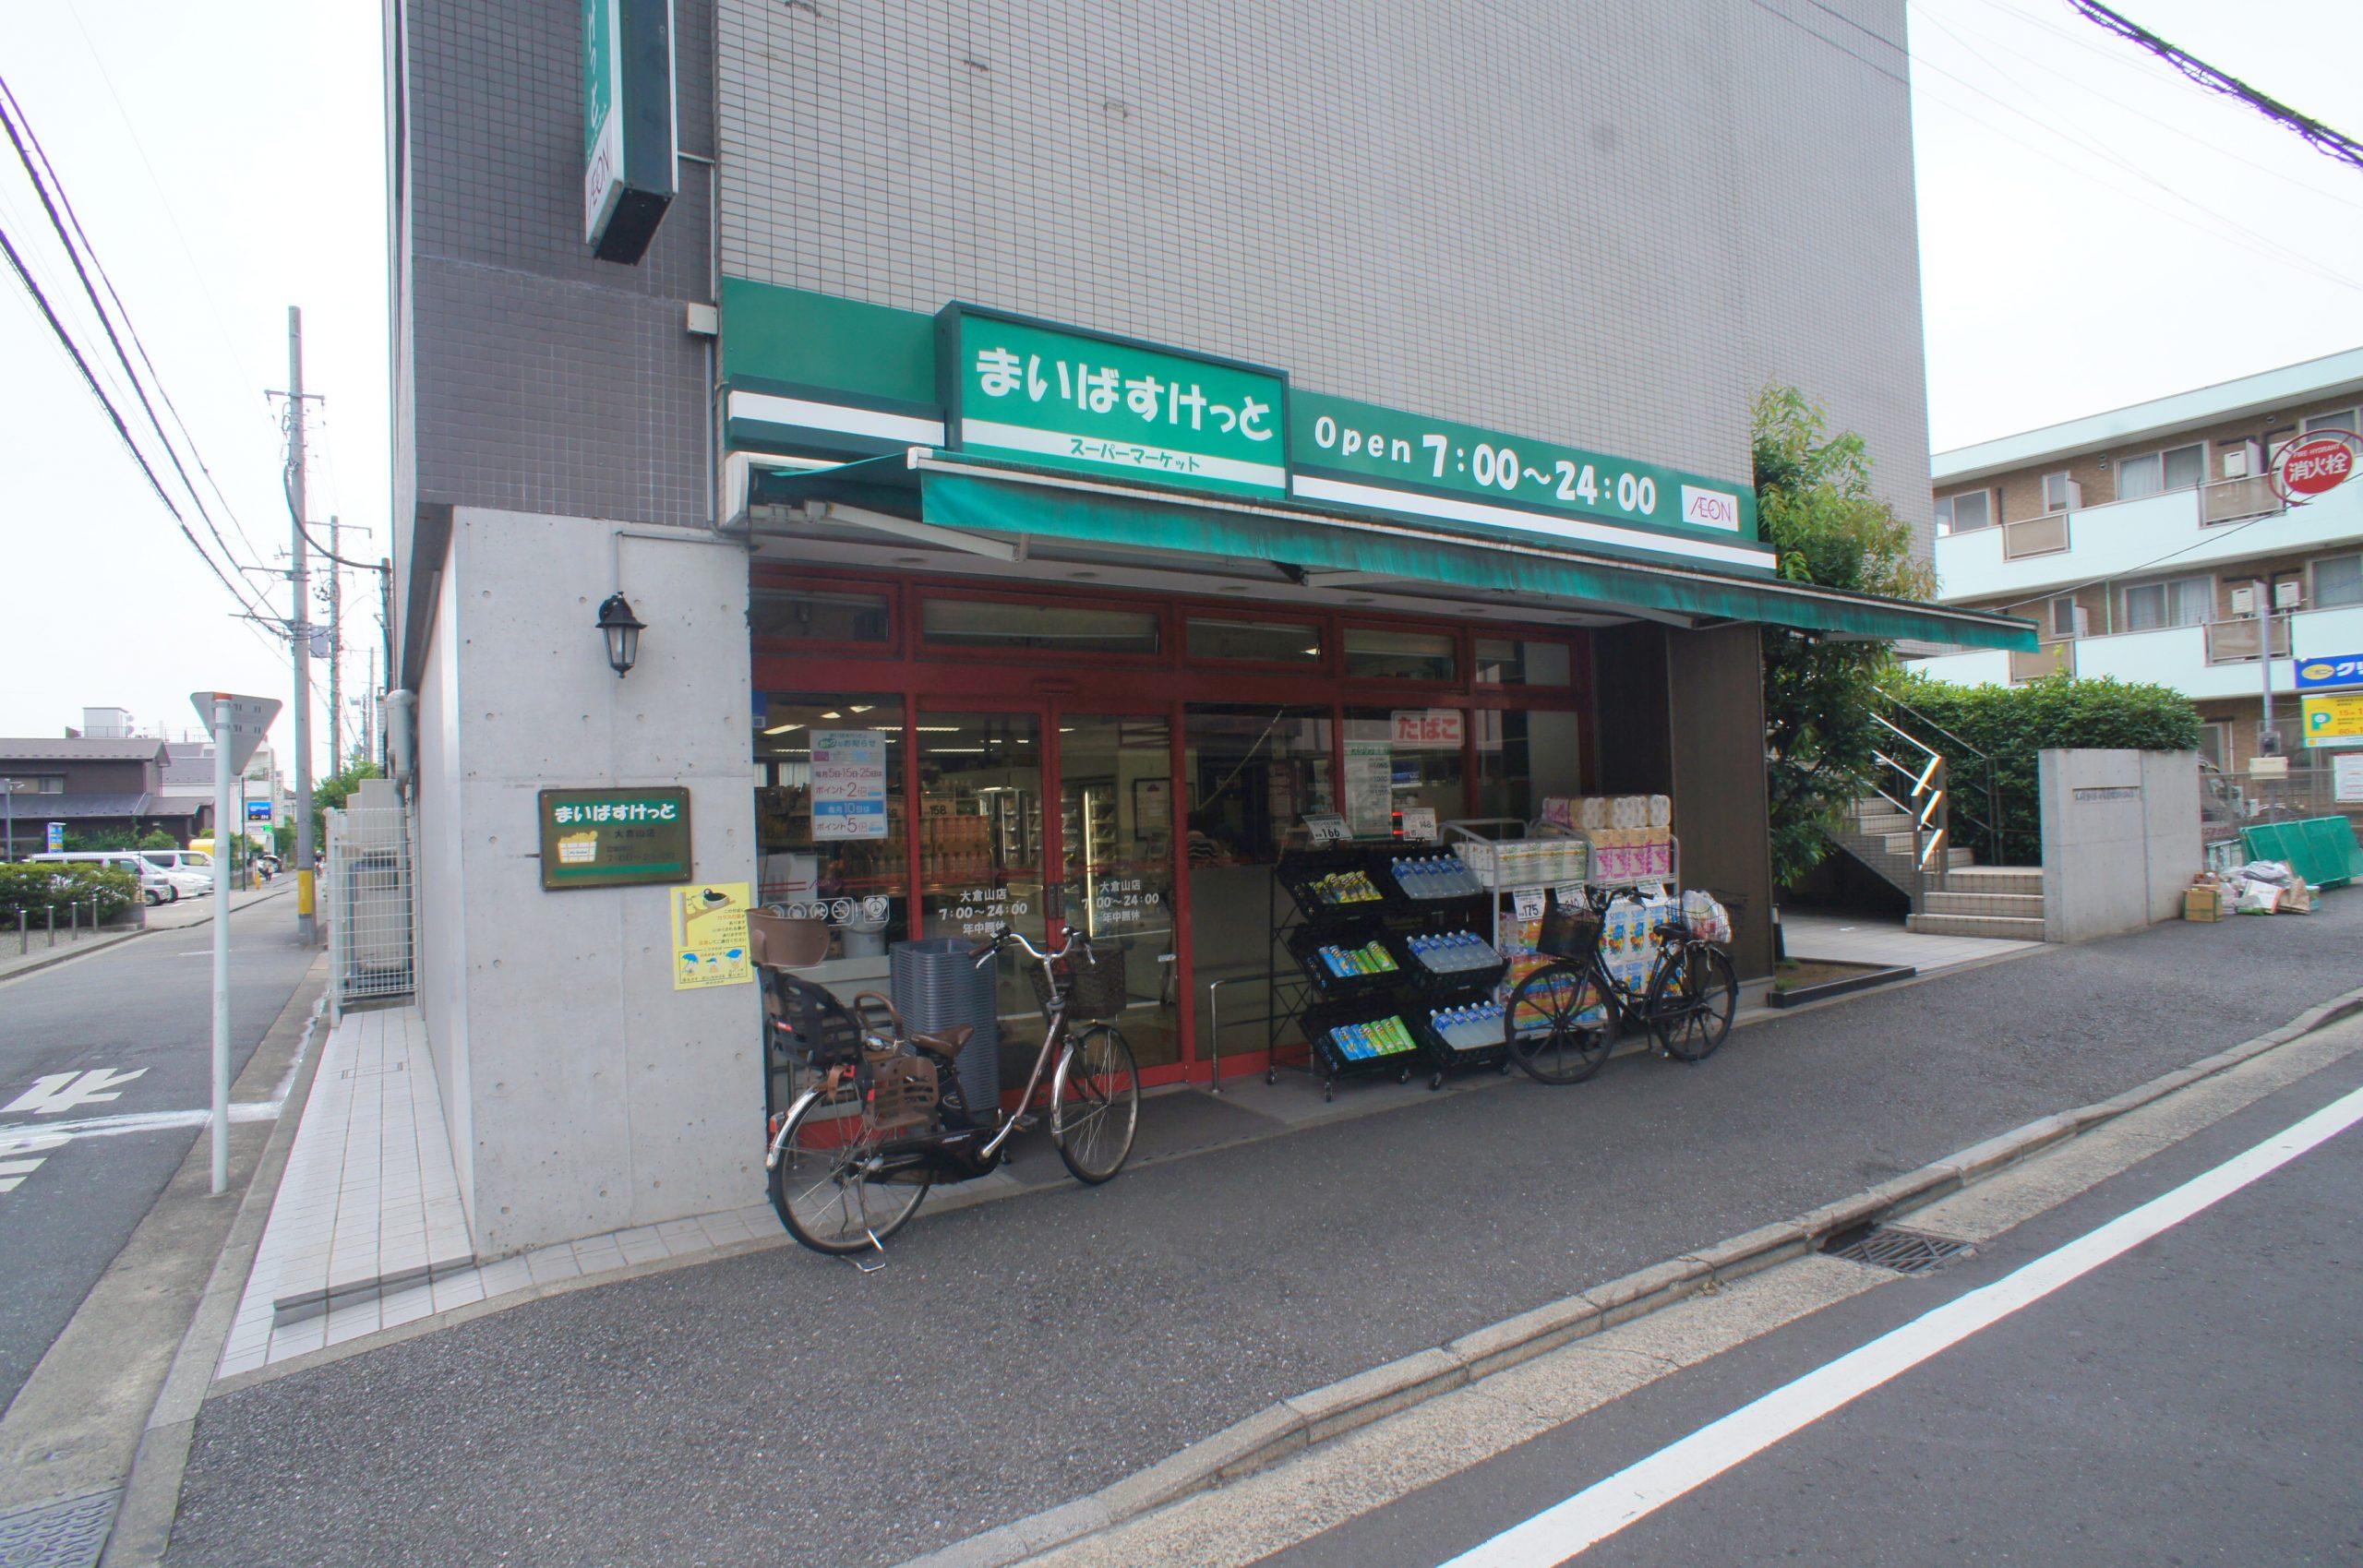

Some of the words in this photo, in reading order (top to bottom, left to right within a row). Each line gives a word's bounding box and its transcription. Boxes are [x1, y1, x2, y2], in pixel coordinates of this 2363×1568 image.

[977, 347, 1274, 441] まいばすけっと
[1314, 416, 1411, 463] Open
[1071, 437, 1200, 473] スーパーマーケット
[2289, 451, 2348, 483] 消火栓
[1397, 716, 1459, 739] たばこ
[555, 803, 676, 823] まいばすけっと
[1322, 828, 1340, 838] 166
[960, 889, 1007, 903] 大倉山店
[1099, 880, 1141, 892] 大倉山店
[1102, 910, 1141, 923] 年中無休
[1523, 904, 1539, 917] 175
